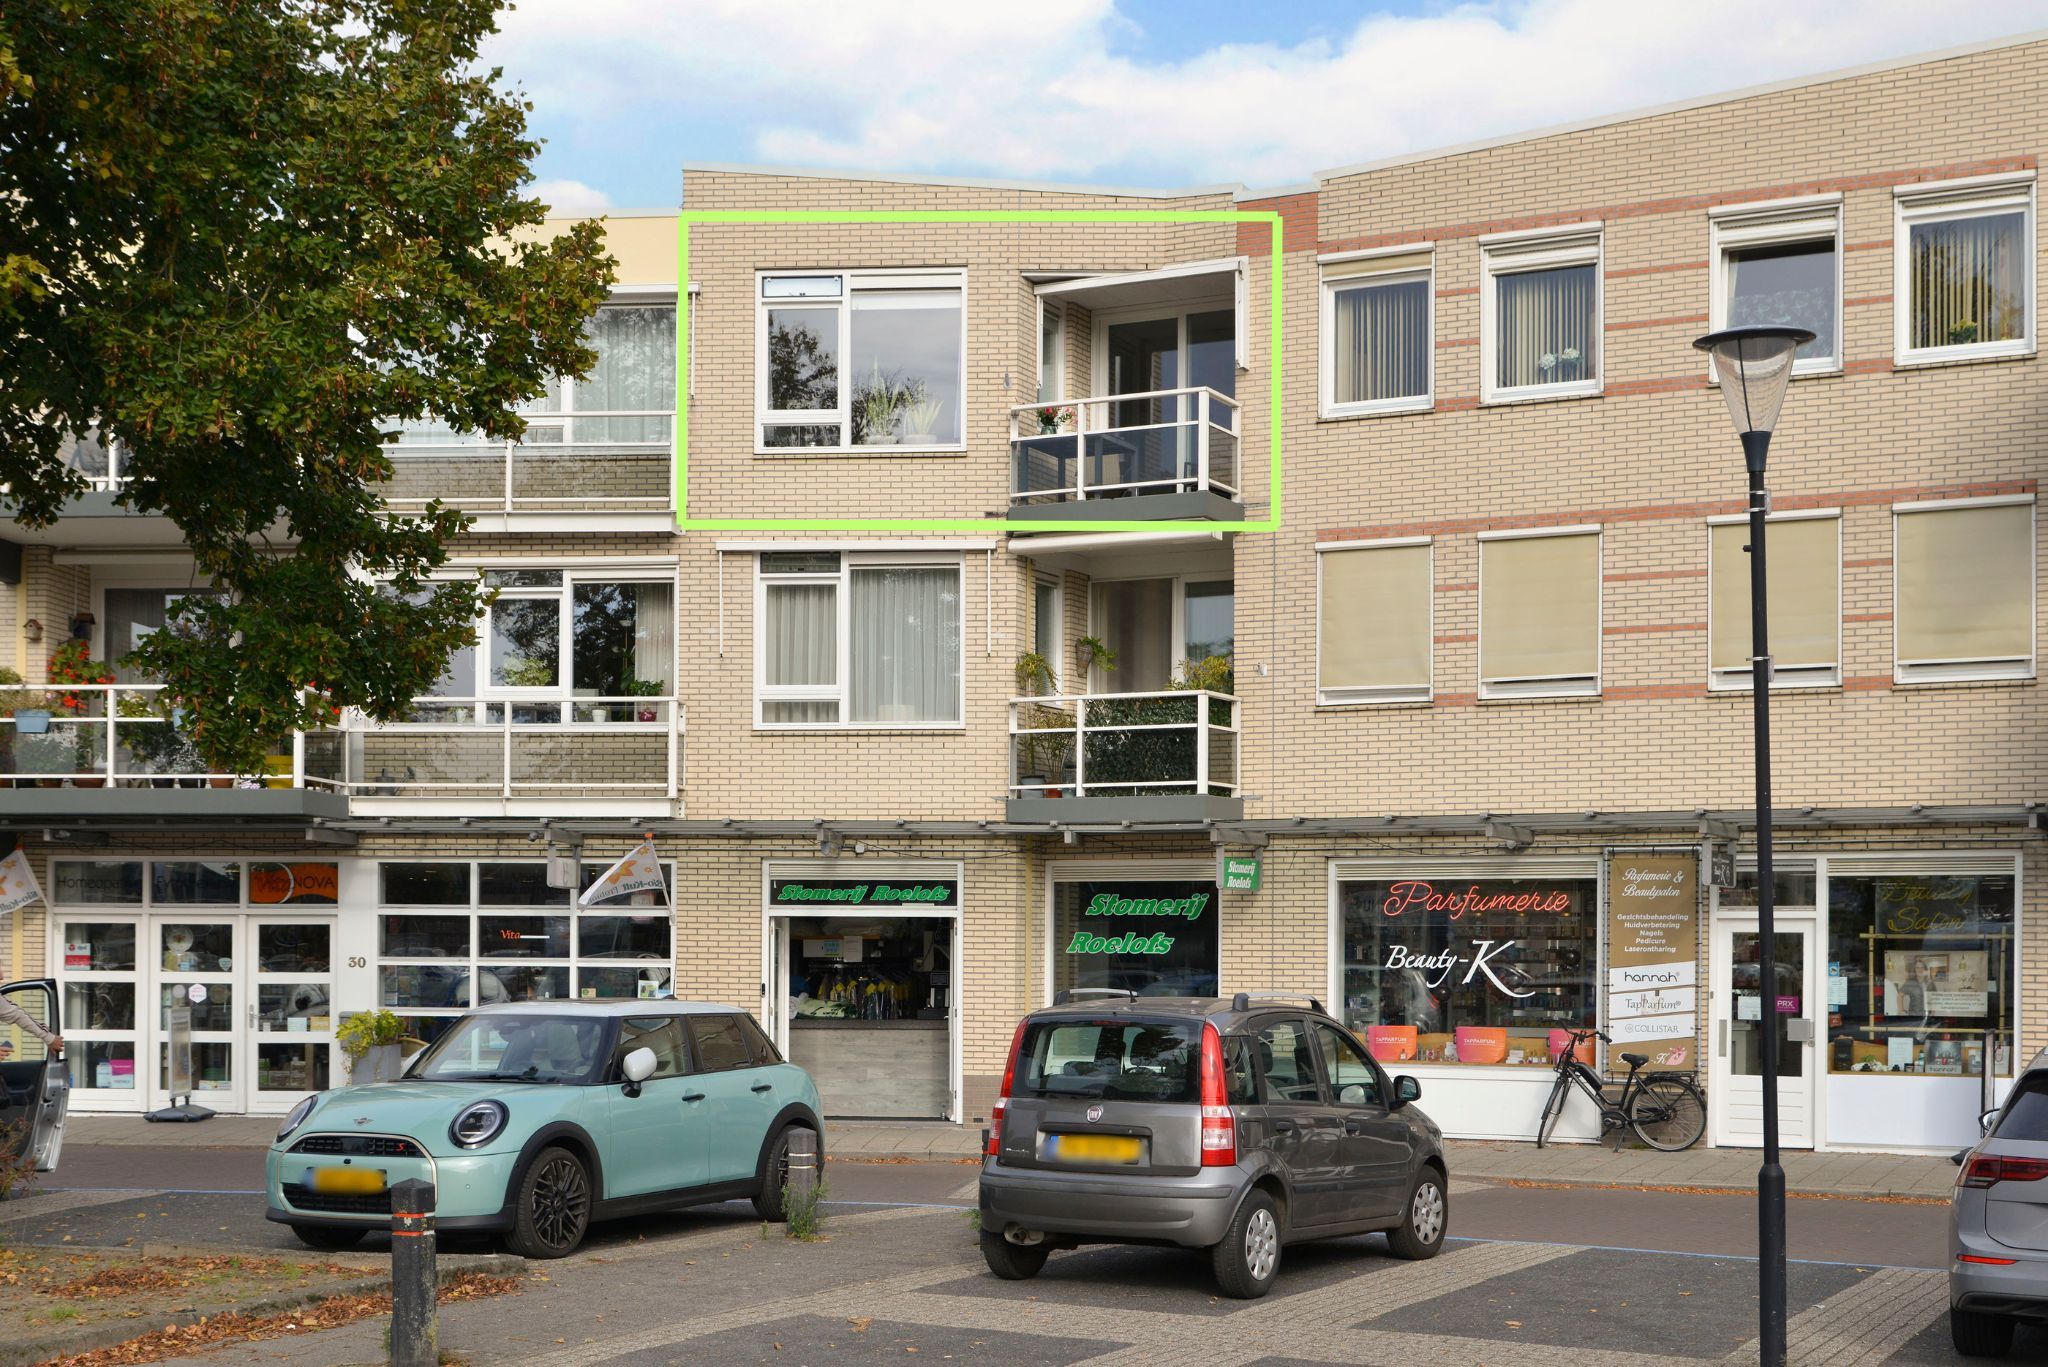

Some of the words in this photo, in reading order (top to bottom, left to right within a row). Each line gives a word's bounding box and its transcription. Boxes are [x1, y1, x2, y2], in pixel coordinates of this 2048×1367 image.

[1227, 861, 1256, 876] Stomerij
[1622, 868, 1671, 884] Parfumerie
[1673, 870, 1684, 883] &
[1227, 876, 1252, 889] Roelofs
[778, 885, 868, 904] Stomerij
[870, 885, 950, 901] Roelofs
[1622, 884, 1681, 900] Beautysalon
[1086, 893, 1210, 920] Stomerij
[1384, 881, 1569, 919] Parfumerie
[1617, 913, 1689, 921] Gezichtsbehandeling
[501, 930, 521, 940] Vita
[1066, 932, 1175, 954] Roelofs
[348, 957, 366, 968] 30
[1385, 939, 1536, 998] Beauty-K
[1634, 1024, 1679, 1033] COLLISTAR
[396, 1143, 404, 1151] S
